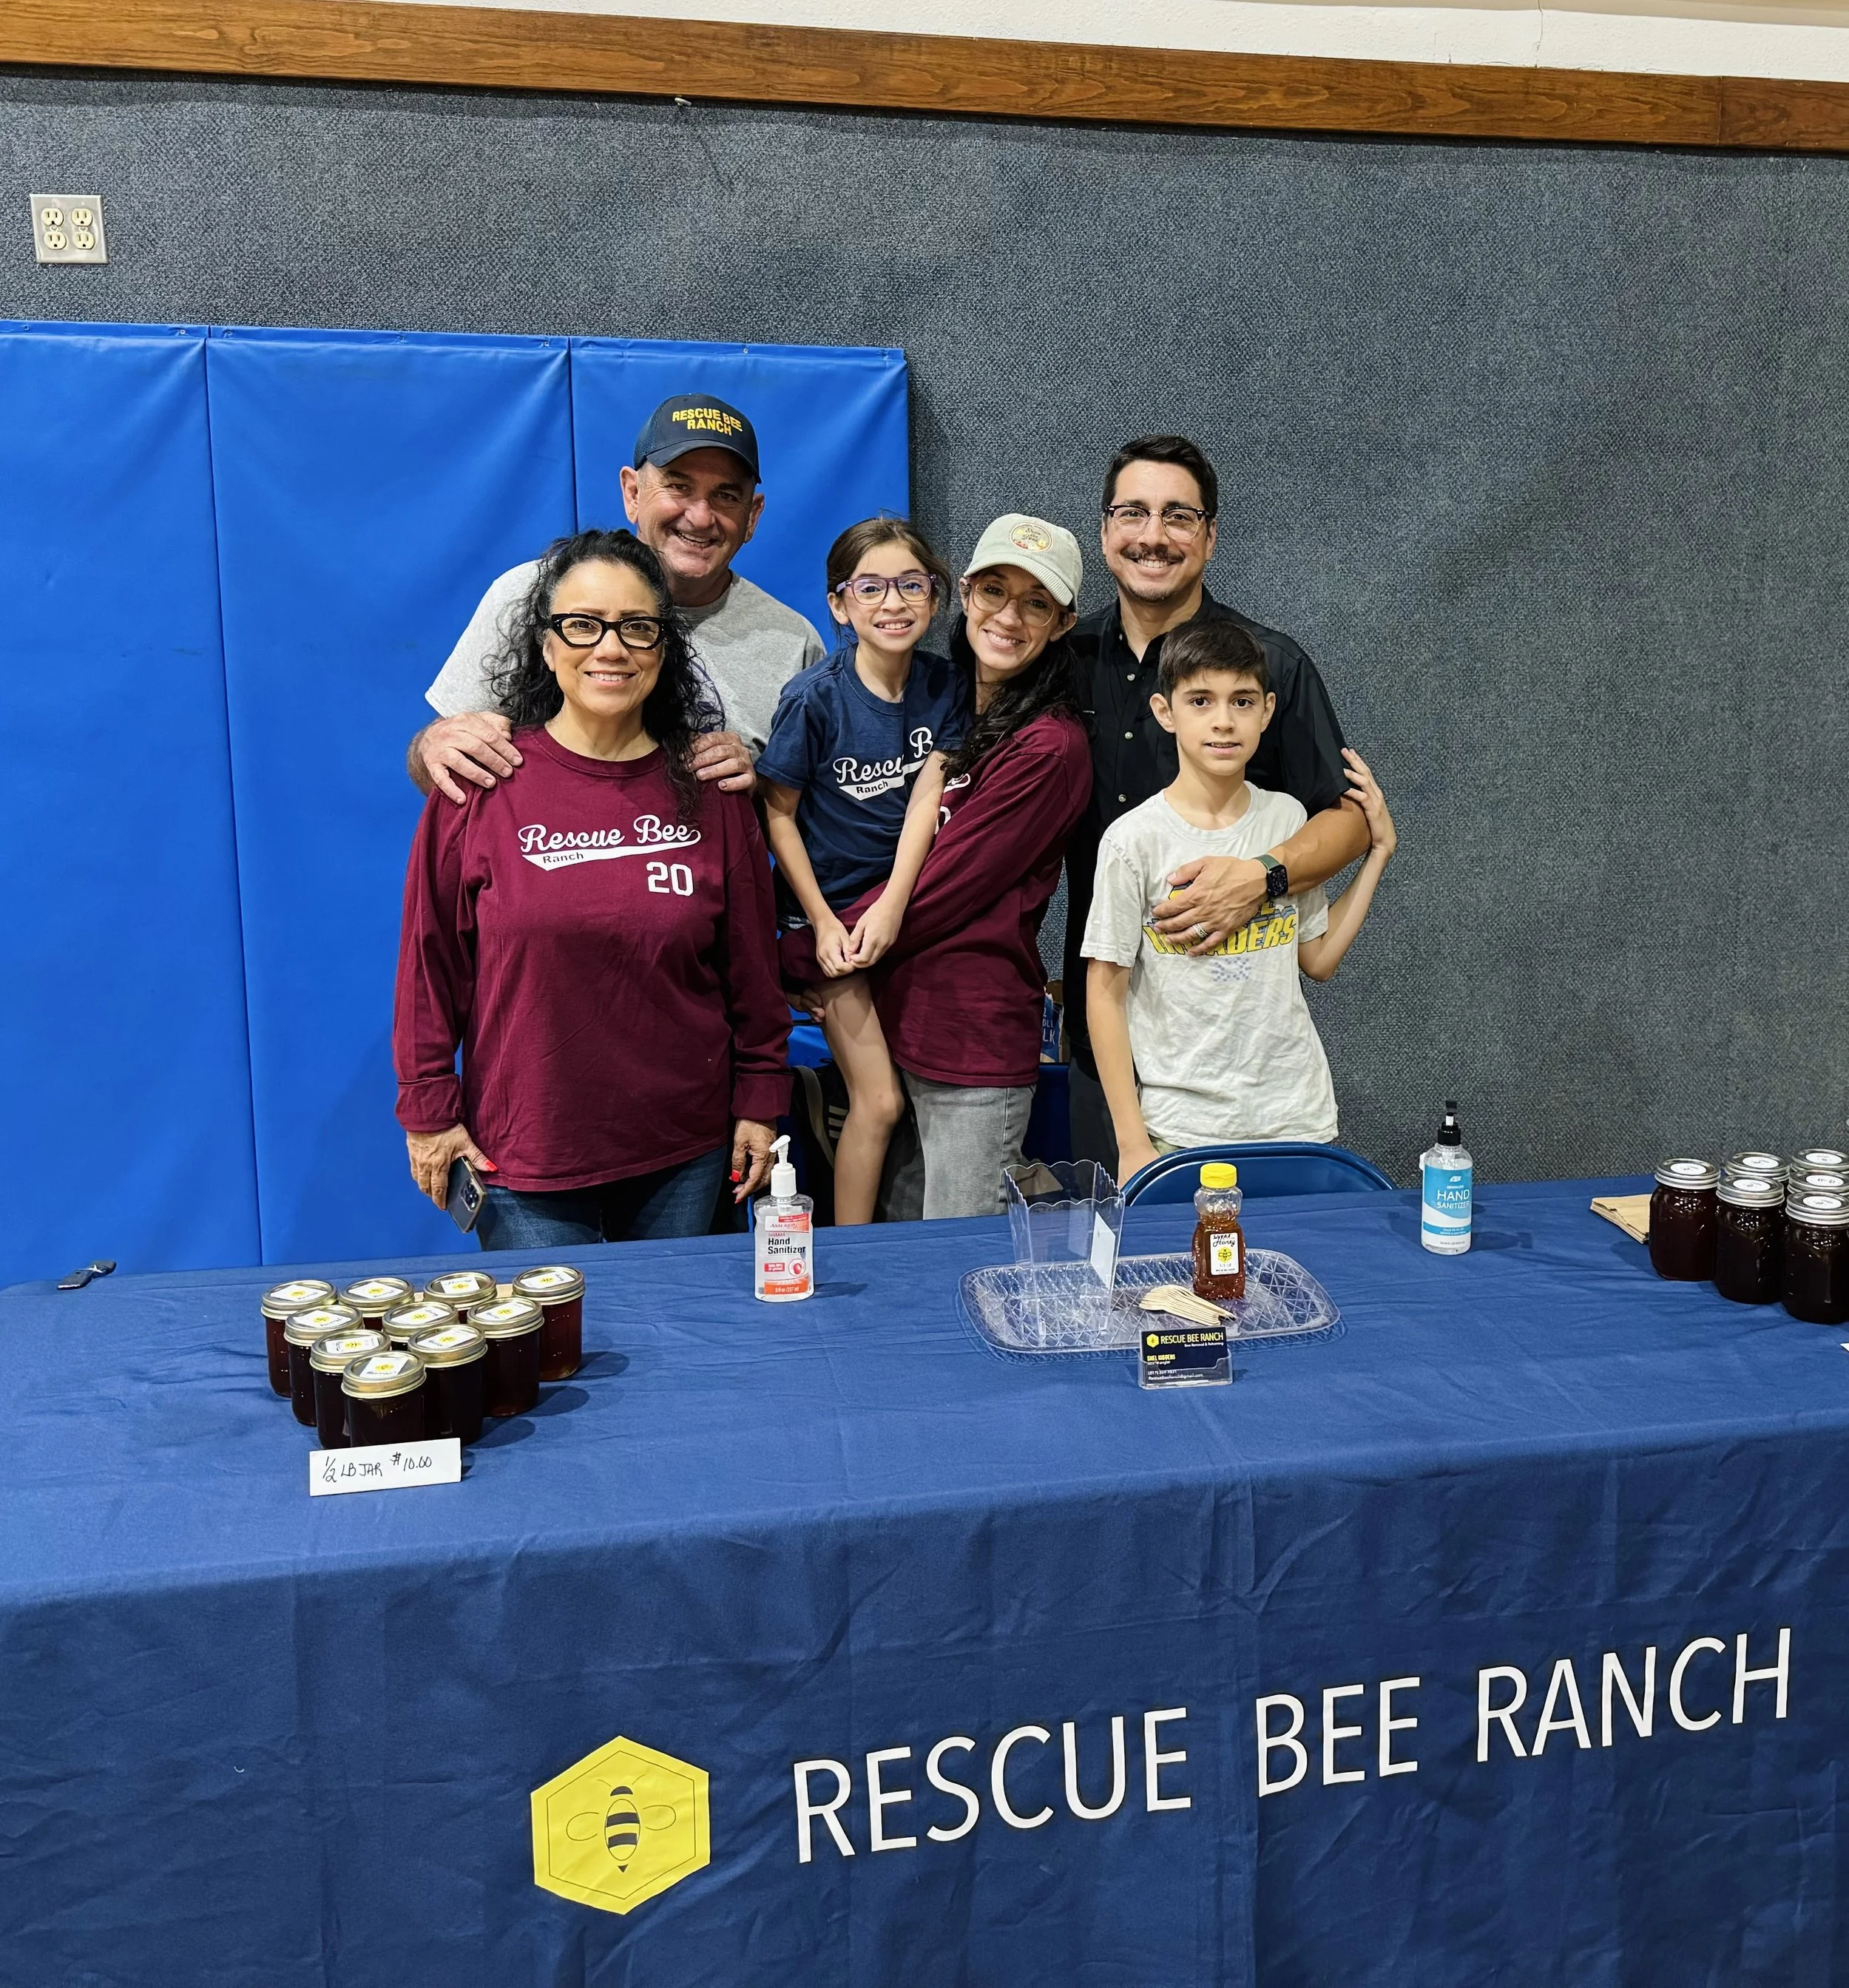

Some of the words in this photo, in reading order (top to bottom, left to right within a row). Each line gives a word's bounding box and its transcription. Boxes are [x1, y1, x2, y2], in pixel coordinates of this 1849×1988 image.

[672, 408, 721, 422] RESCUE
[722, 412, 743, 432] BEE
[687, 418, 732, 436] RANCH
[833, 753, 904, 784] Resc
[856, 780, 888, 794] Ranch
[518, 824, 626, 853] Rescue
[633, 814, 701, 844] Bee
[542, 851, 584, 864] Ranch
[646, 861, 694, 896] 20
[1437, 1189, 1470, 1201] HAND
[1436, 1200, 1470, 1209] SANITIZER
[768, 1237, 791, 1245] Hand
[768, 1245, 806, 1254] Sanitizer
[1160, 1334, 1186, 1345] RESCUE
[1186, 1333, 1200, 1342] BEE
[1200, 1332, 1224, 1342] RANCH
[341, 1462, 356, 1477] LB
[359, 1462, 383, 1477] JAR
[794, 1707, 1191, 1864] RESCUE
[1256, 1677, 1420, 1798] BEE
[1477, 1628, 1791, 1762] RANCH
